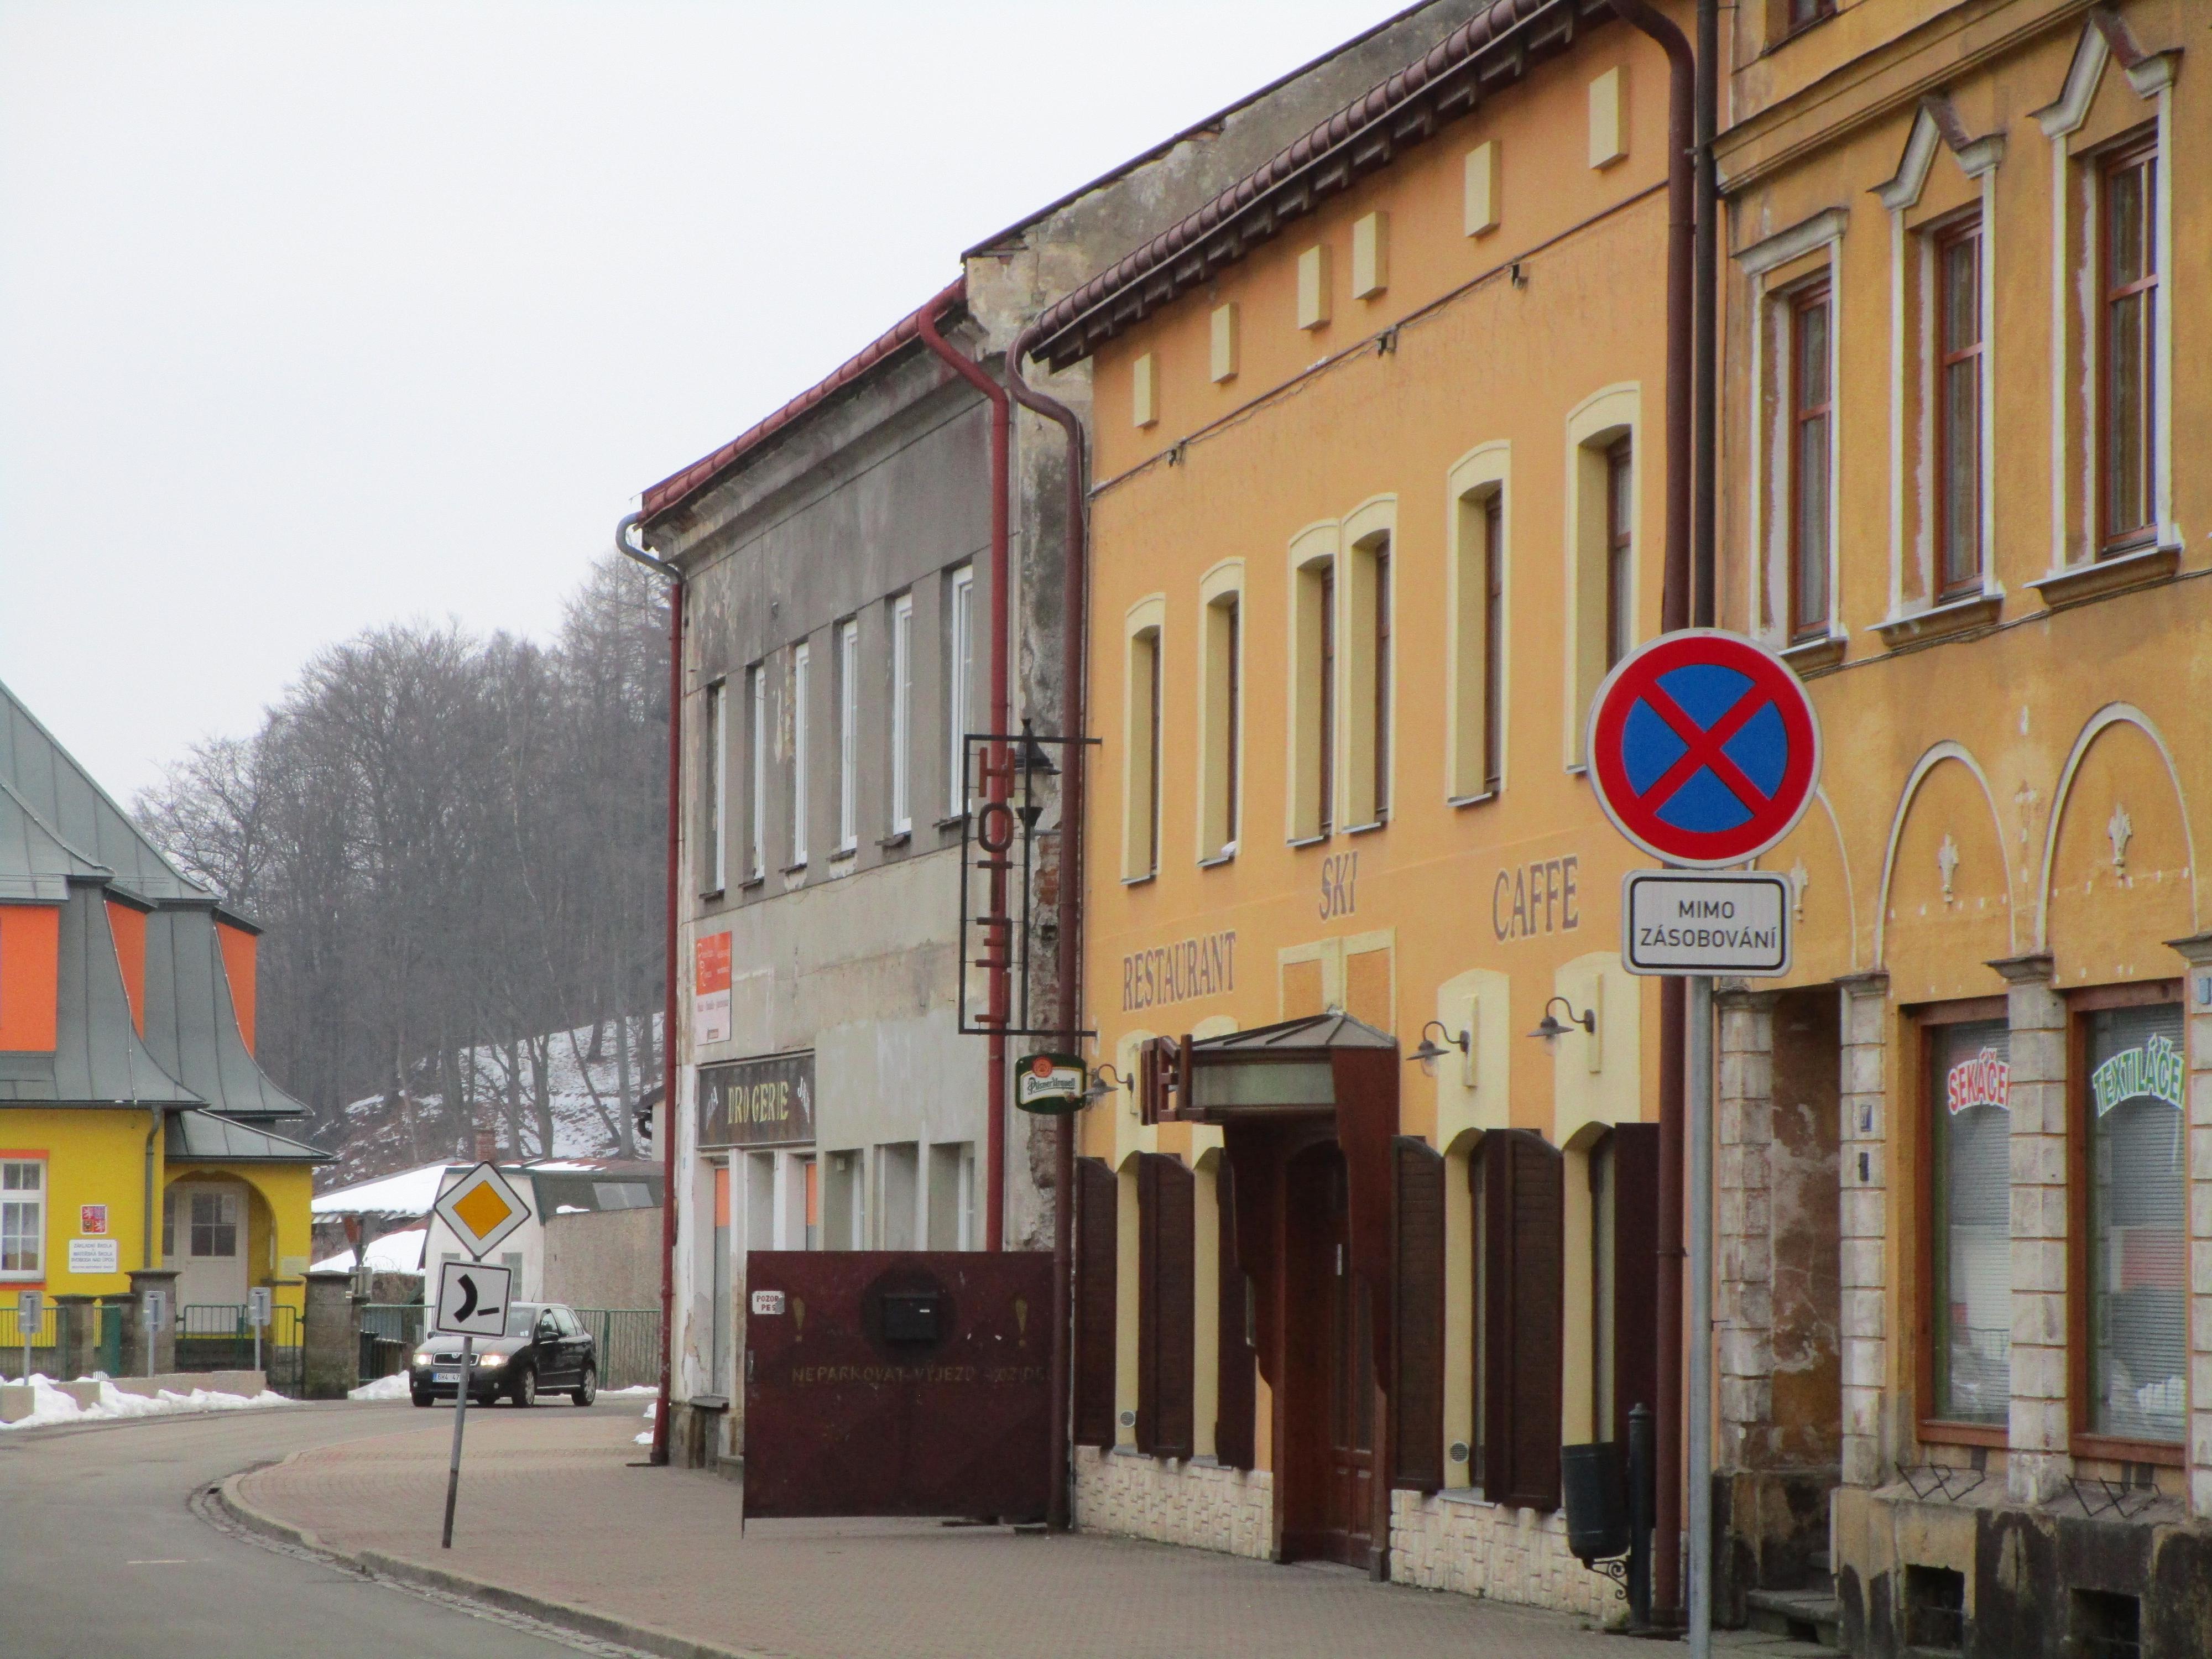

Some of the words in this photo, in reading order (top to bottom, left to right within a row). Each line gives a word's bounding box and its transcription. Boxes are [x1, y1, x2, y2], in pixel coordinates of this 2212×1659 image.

[1318, 850, 1359, 921] SKI
[1492, 855, 1579, 942] CAFFE
[1678, 900, 1735, 919] MIMO
[1122, 930, 1237, 1011] RESTAURANT
[1640, 925, 1777, 948] ZÁSOBOVÁNÍ
[728, 1081, 789, 1124] DROGERIE
[1948, 1047, 2010, 1114] SEKÁČE
[2093, 1033, 2184, 1118] TEXTILÁČE
